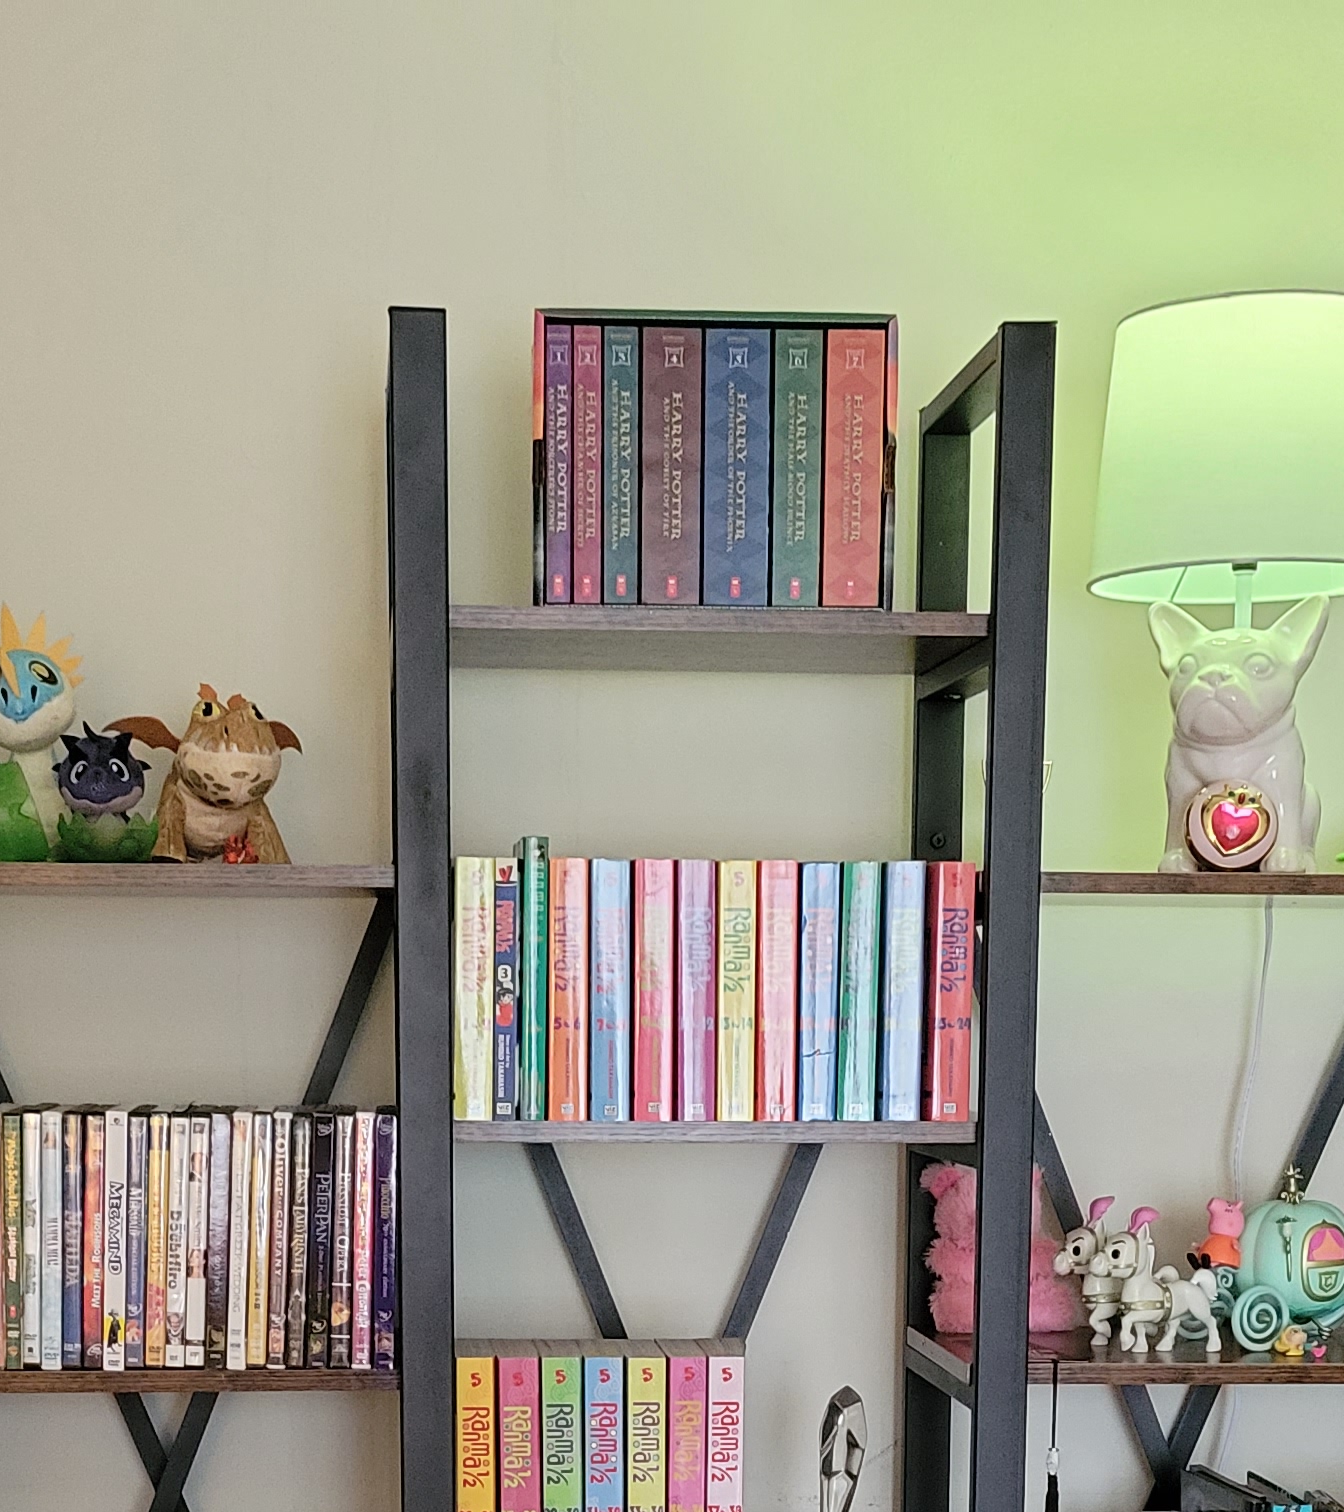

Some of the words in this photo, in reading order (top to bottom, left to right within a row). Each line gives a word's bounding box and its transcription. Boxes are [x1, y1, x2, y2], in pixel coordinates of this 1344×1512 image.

[557, 384, 568, 455] HARRY
[585, 391, 597, 465] HARRY
[620, 391, 631, 463] HARRY
[671, 392, 683, 463] HARRY
[736, 393, 747, 463] HARRY
[796, 395, 807, 464] HARRY
[851, 395, 863, 464] HARRY
[557, 462, 567, 532] POTTER
[585, 471, 595, 538] POTTER
[620, 469, 630, 538] POTTER
[671, 470, 682, 540] POTTER
[735, 471, 745, 540] POTTER
[794, 472, 806, 541] POTTER
[851, 472, 862, 542] POTTER
[107, 1181, 125, 1275] MEGAMIND
[274, 1210, 284, 1278] COMPANY
[462, 1407, 490, 1467] Ranma
[504, 1406, 531, 1467] Ranma
[546, 1404, 574, 1465] Ranma
[590, 1403, 617, 1464] Ranma
[633, 1402, 660, 1463] Ranma
[712, 1401, 739, 1462] Ranma
